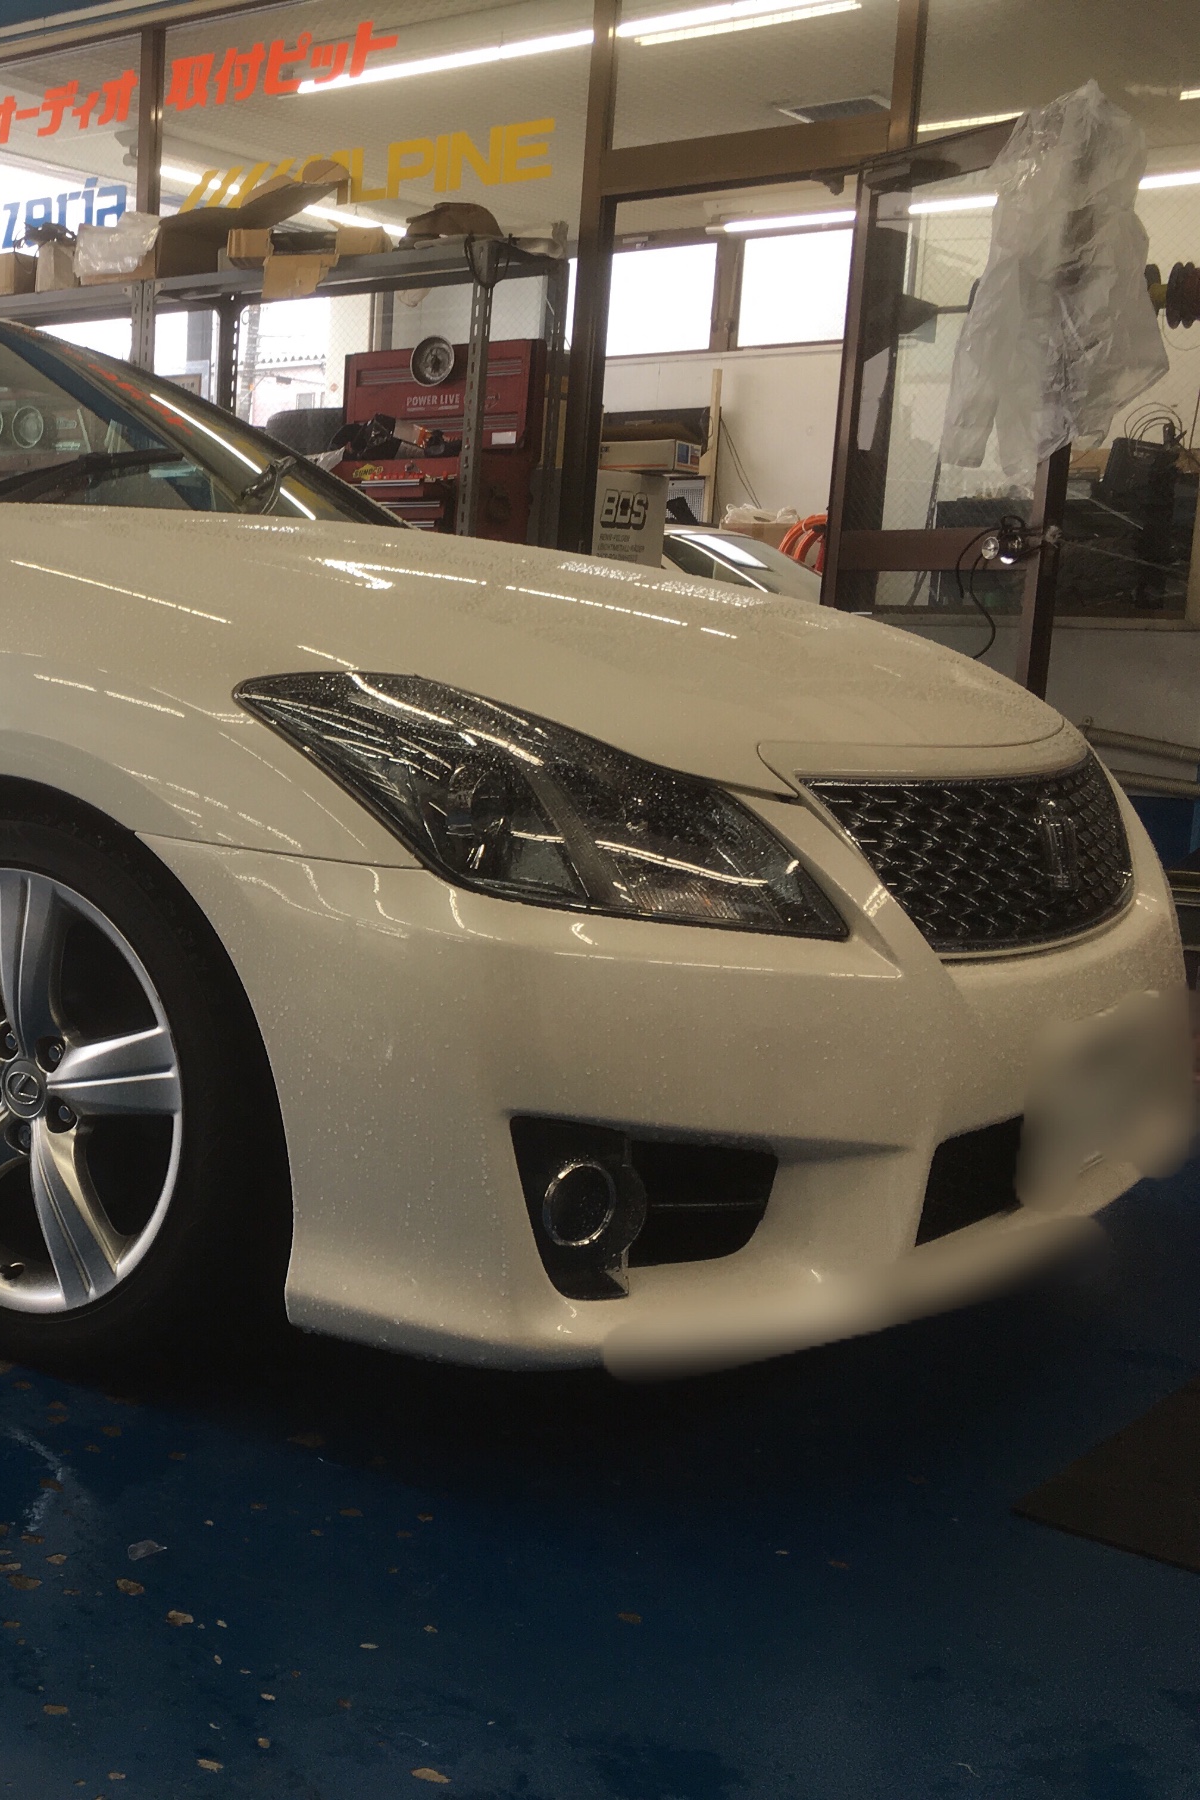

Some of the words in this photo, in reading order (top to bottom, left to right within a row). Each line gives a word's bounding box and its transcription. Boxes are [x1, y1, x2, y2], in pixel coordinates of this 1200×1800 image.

[164, 21, 398, 111] 取付ピット
[406, 394, 438, 407] POWER
[439, 393, 461, 405] LIVE
